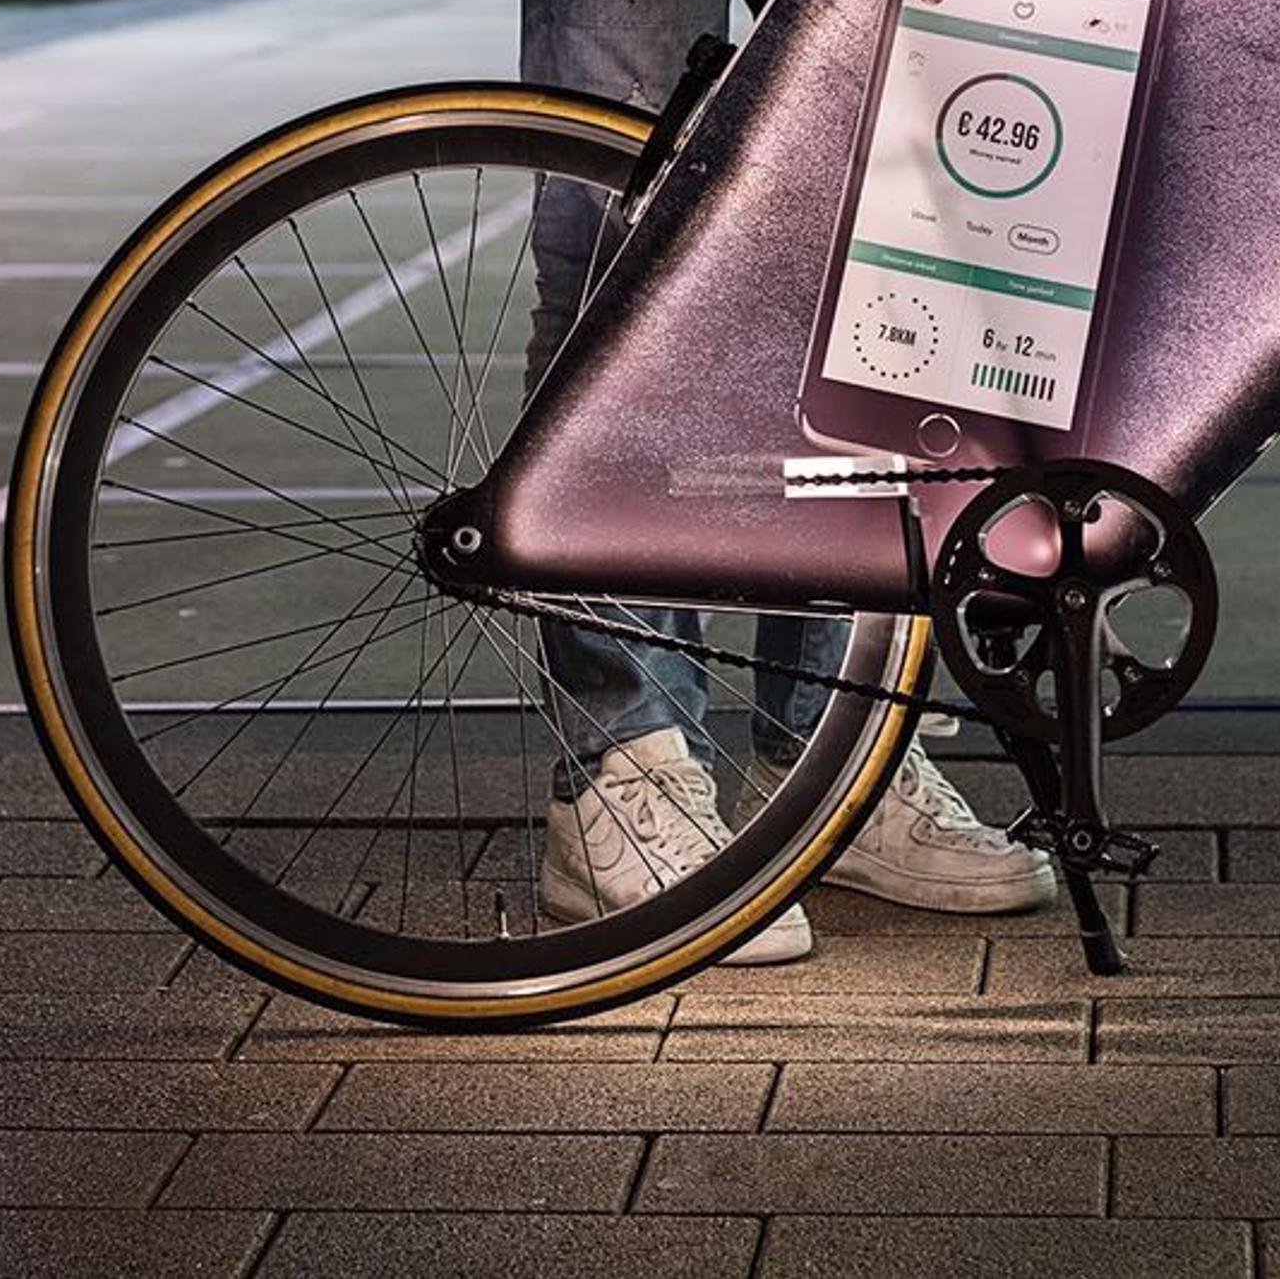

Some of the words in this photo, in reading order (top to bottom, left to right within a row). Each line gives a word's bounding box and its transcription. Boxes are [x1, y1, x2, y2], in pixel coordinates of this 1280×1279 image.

[976, 115, 1040, 150] 42.96
[1017, 232, 1049, 246] Month
[983, 328, 995, 349] 6
[1014, 335, 1034, 357] 12
